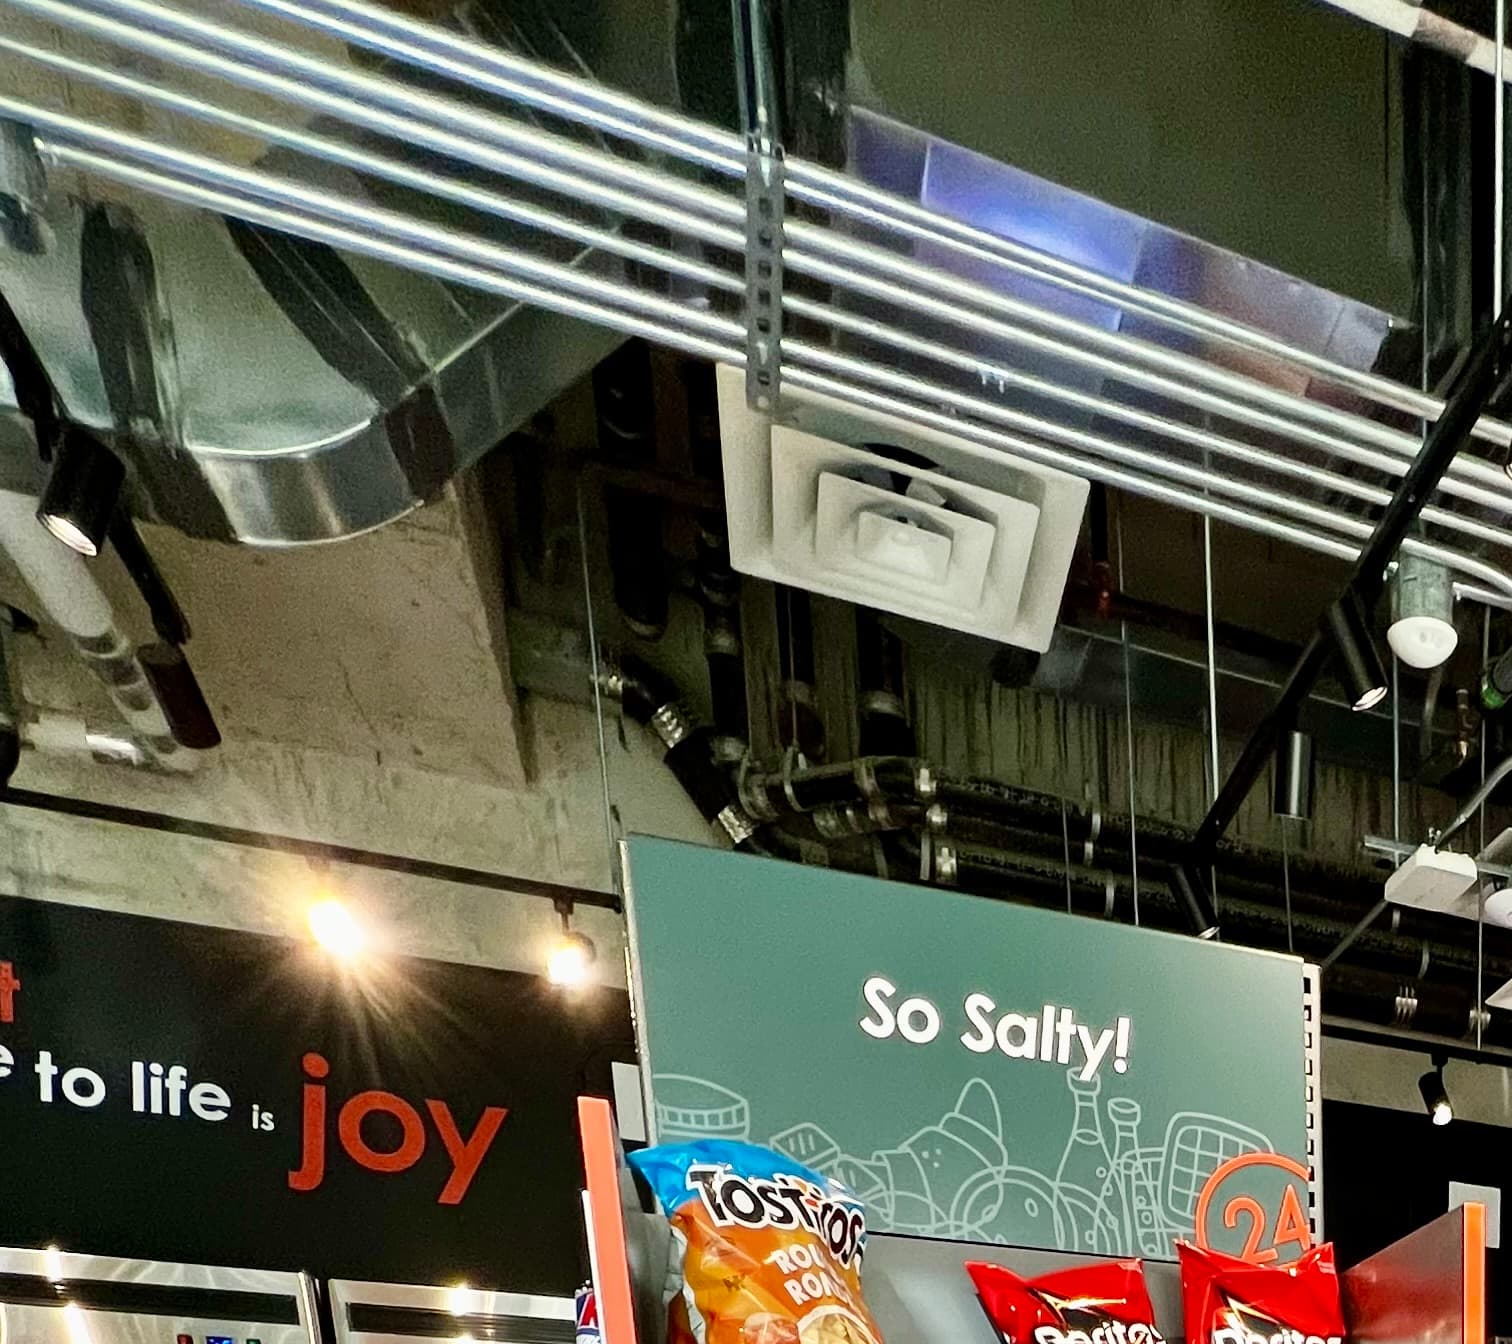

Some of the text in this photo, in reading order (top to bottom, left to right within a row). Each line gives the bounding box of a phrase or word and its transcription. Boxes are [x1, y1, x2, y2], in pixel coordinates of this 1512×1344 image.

[860, 976, 1132, 1082] So Salty!
[35, 1051, 105, 1107] to
[132, 1060, 231, 1121] life
[252, 1105, 275, 1131] is
[288, 1052, 508, 1205] joy
[1224, 1184, 1313, 1264] 24
